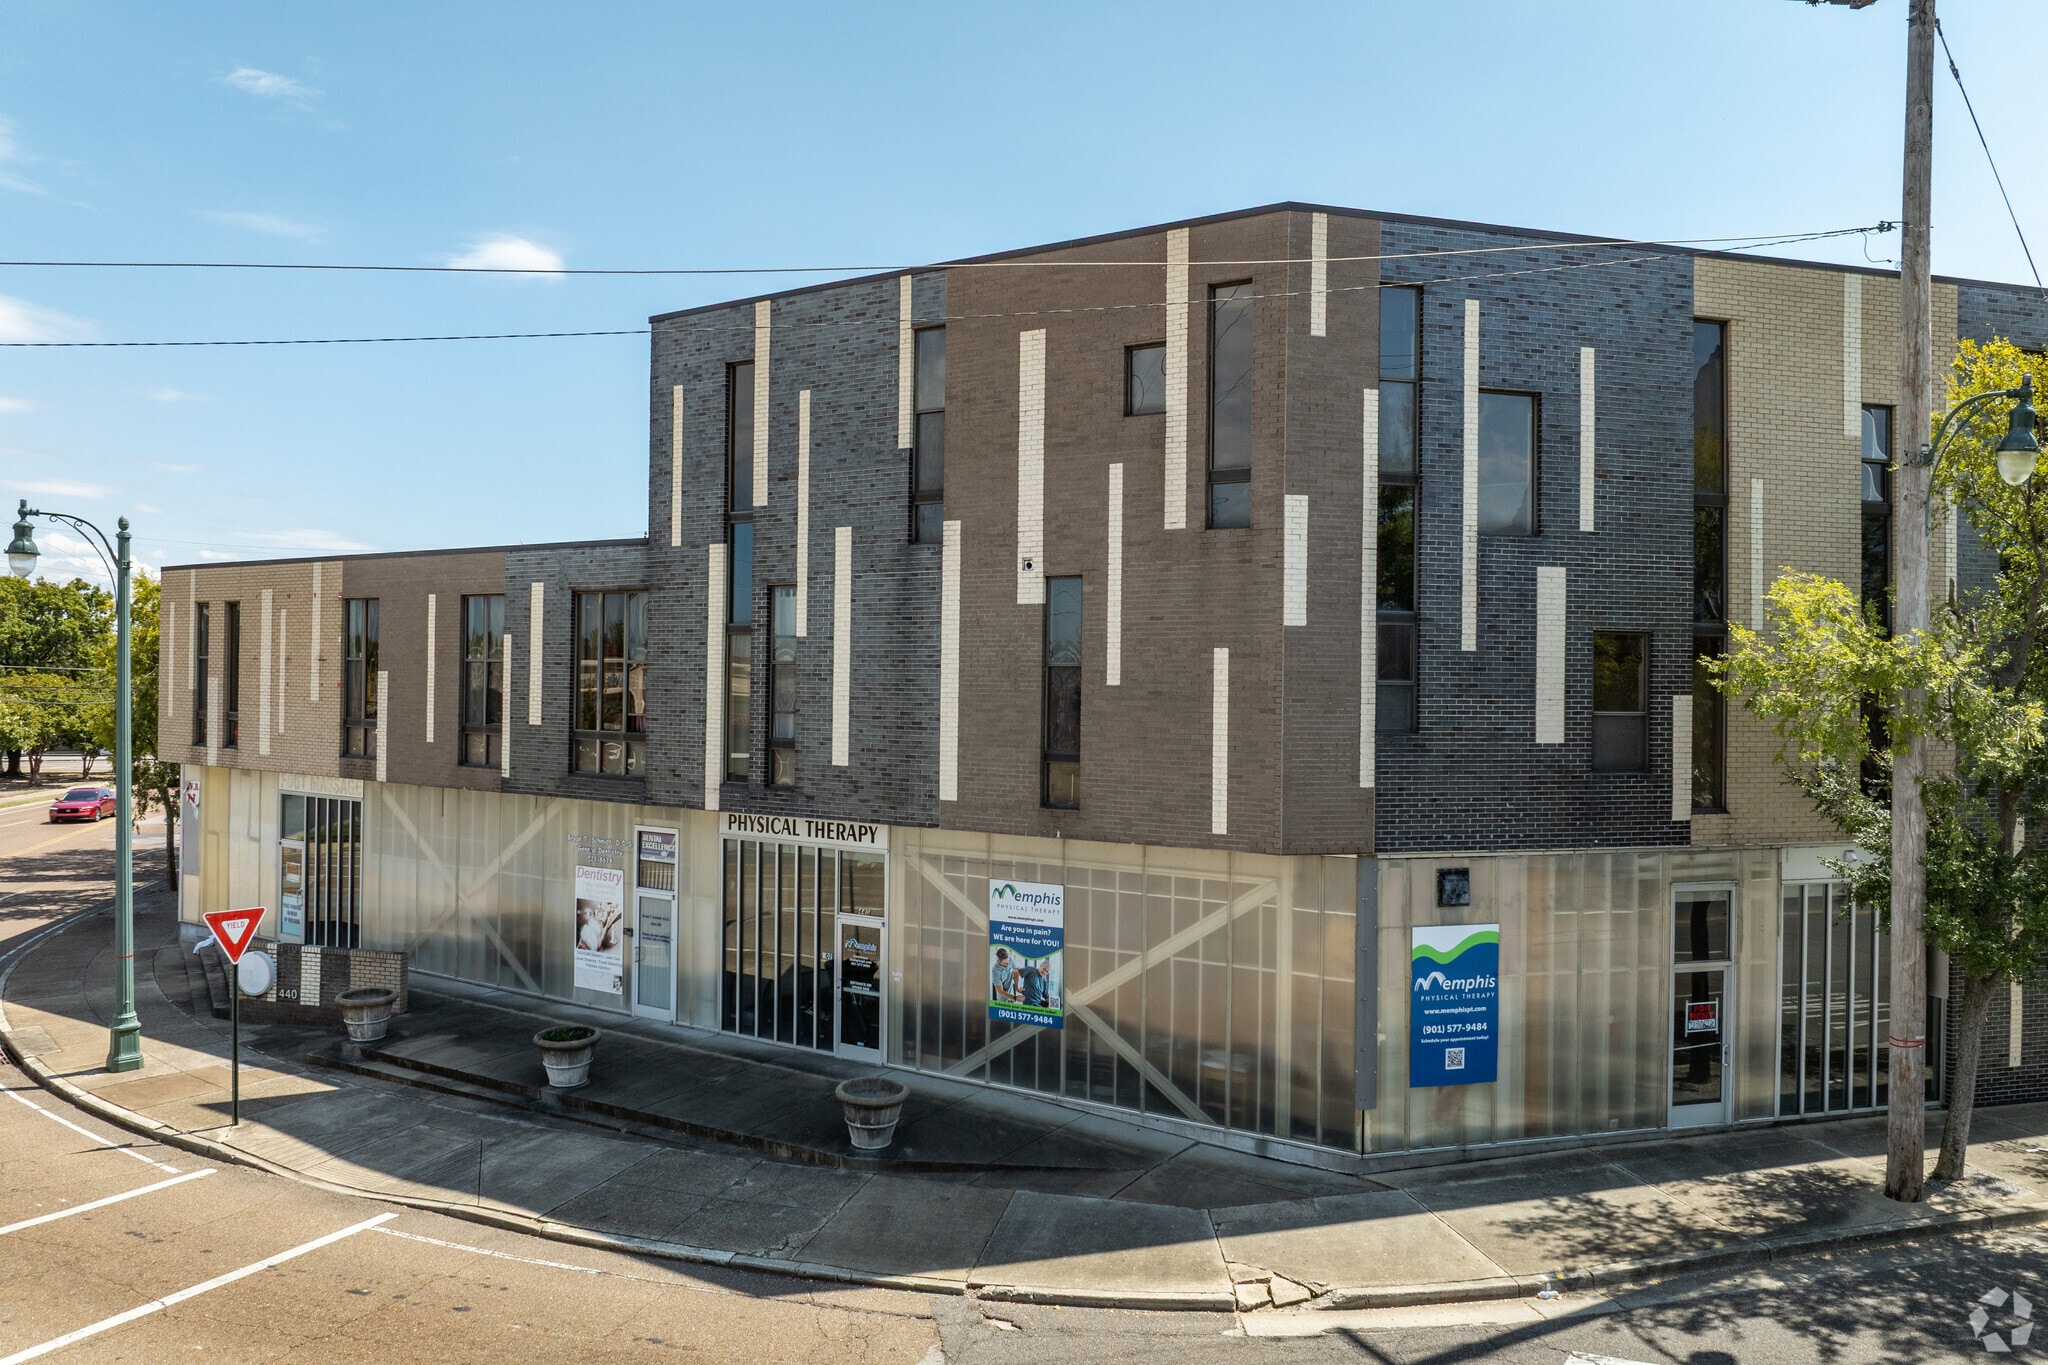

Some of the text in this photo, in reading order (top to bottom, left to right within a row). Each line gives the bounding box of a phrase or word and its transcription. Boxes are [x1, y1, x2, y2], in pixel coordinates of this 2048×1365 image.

[728, 814, 878, 844] PHYSICAL THERAPY
[567, 834, 582, 843] Bryan
[591, 837, 612, 845] Schmidt
[642, 834, 662, 843] DENTAL
[598, 847, 623, 857] Dentistry
[642, 841, 676, 852] EXCELLENCE
[576, 866, 622, 886] Dentistry
[991, 884, 1061, 906] Memphis
[996, 903, 1028, 912] PHYSICAL
[226, 920, 245, 929] YIELD
[1001, 924, 1012, 932] Are
[993, 933, 1004, 941] WE
[1042, 939, 1060, 948] YOU!
[1414, 971, 1496, 993] Memphis
[278, 989, 298, 1000] 440
[1420, 992, 1495, 1002] PHYSICAL THERAPY
[1424, 1006, 1487, 1015] www.memphispt.com
[1689, 1011, 1715, 1020] RENT
[998, 1009, 1053, 1024] (901) 577-9484
[1422, 1022, 1488, 1035] (901) 577-9484
